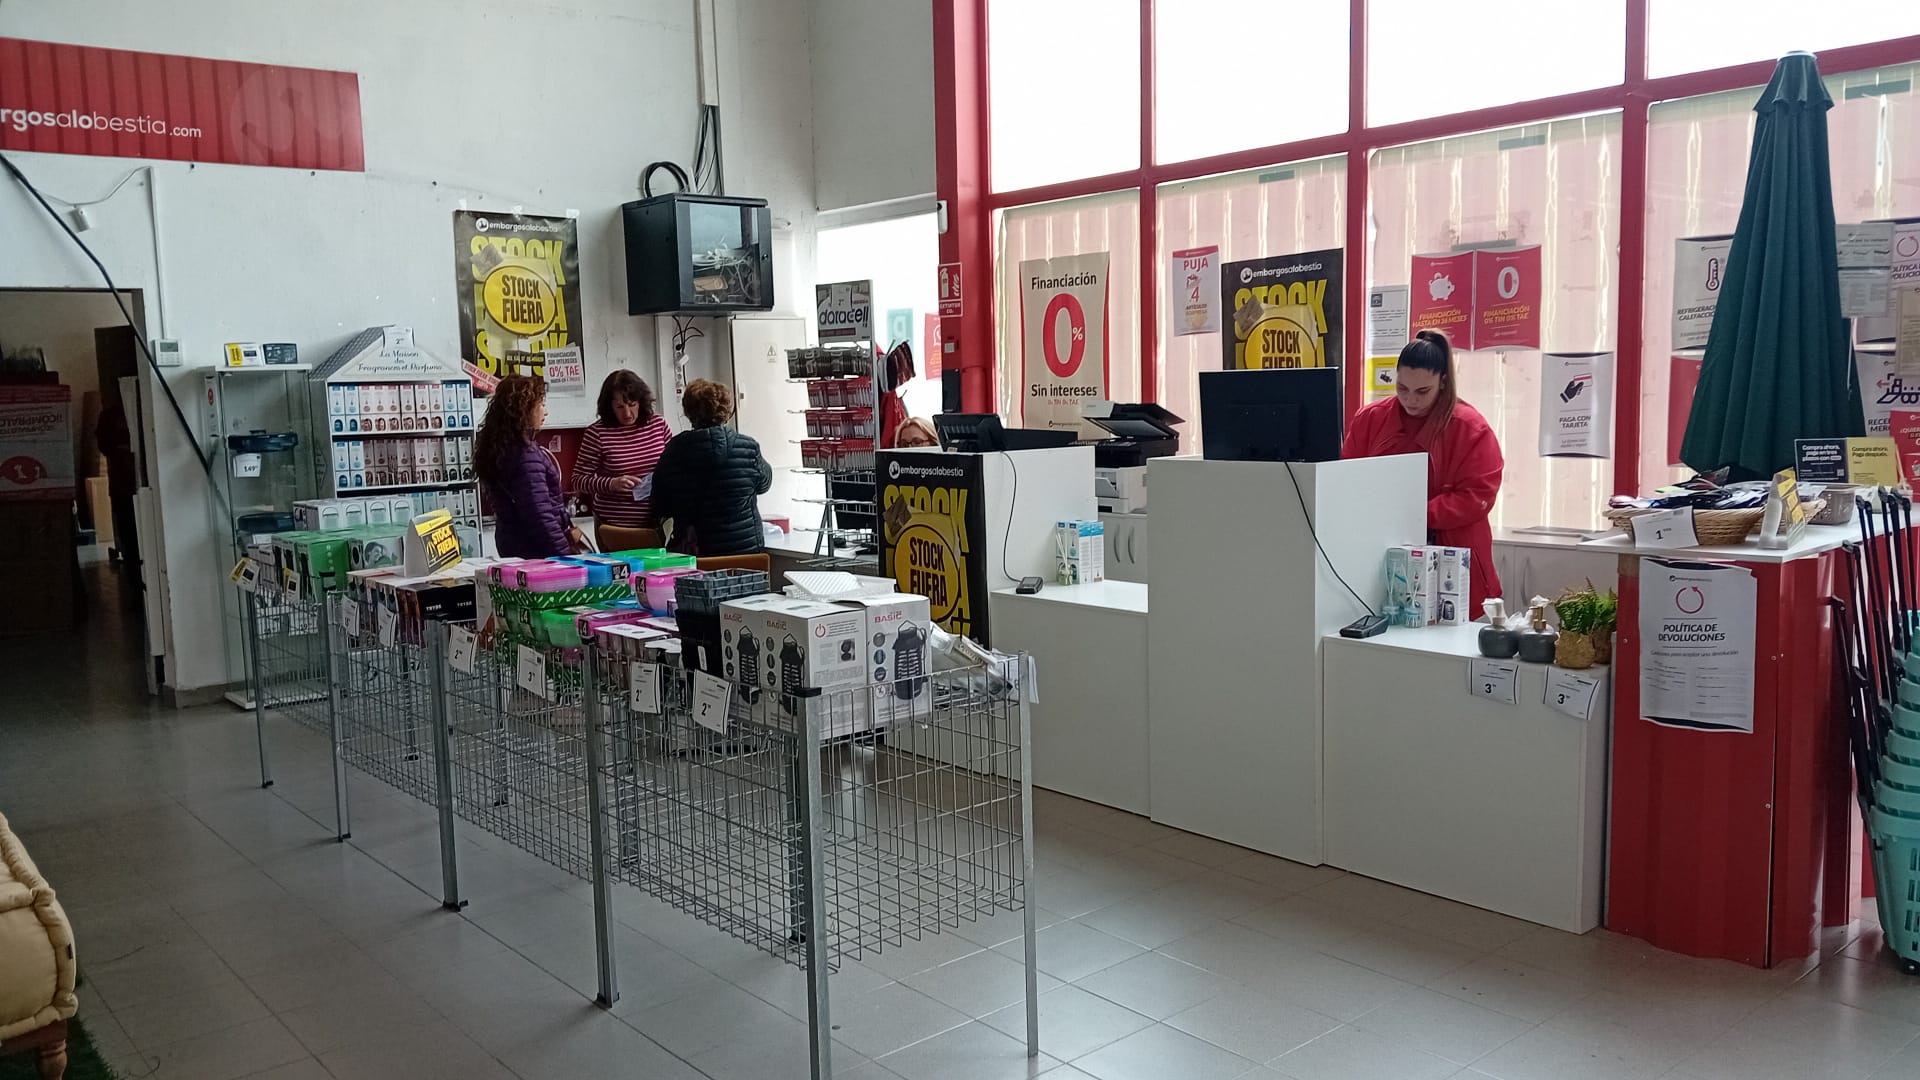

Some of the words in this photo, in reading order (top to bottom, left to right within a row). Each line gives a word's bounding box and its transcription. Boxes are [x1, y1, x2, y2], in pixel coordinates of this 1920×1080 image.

[1184, 257, 1208, 272] PUJA
[1252, 262, 1322, 278] embargosalobestia
[502, 275, 541, 300] STOCK
[1031, 272, 1097, 290] Financiación
[1190, 286, 1200, 302] 4
[502, 299, 544, 324] FUERA
[1261, 329, 1301, 354] STOCK
[549, 366, 564, 378] 0%
[565, 365, 580, 376] TAE
[1031, 384, 1047, 397] Sin
[1049, 384, 1097, 397] intereses
[900, 466, 964, 478] embargosalobestia
[909, 536, 945, 572] STOCK
[620, 565, 629, 578] 4
[874, 612, 902, 623] BASIC
[1663, 622, 1703, 632] POLÍTICA
[1704, 623, 1718, 632] DE
[1658, 632, 1726, 642] DEVOLUCIONES
